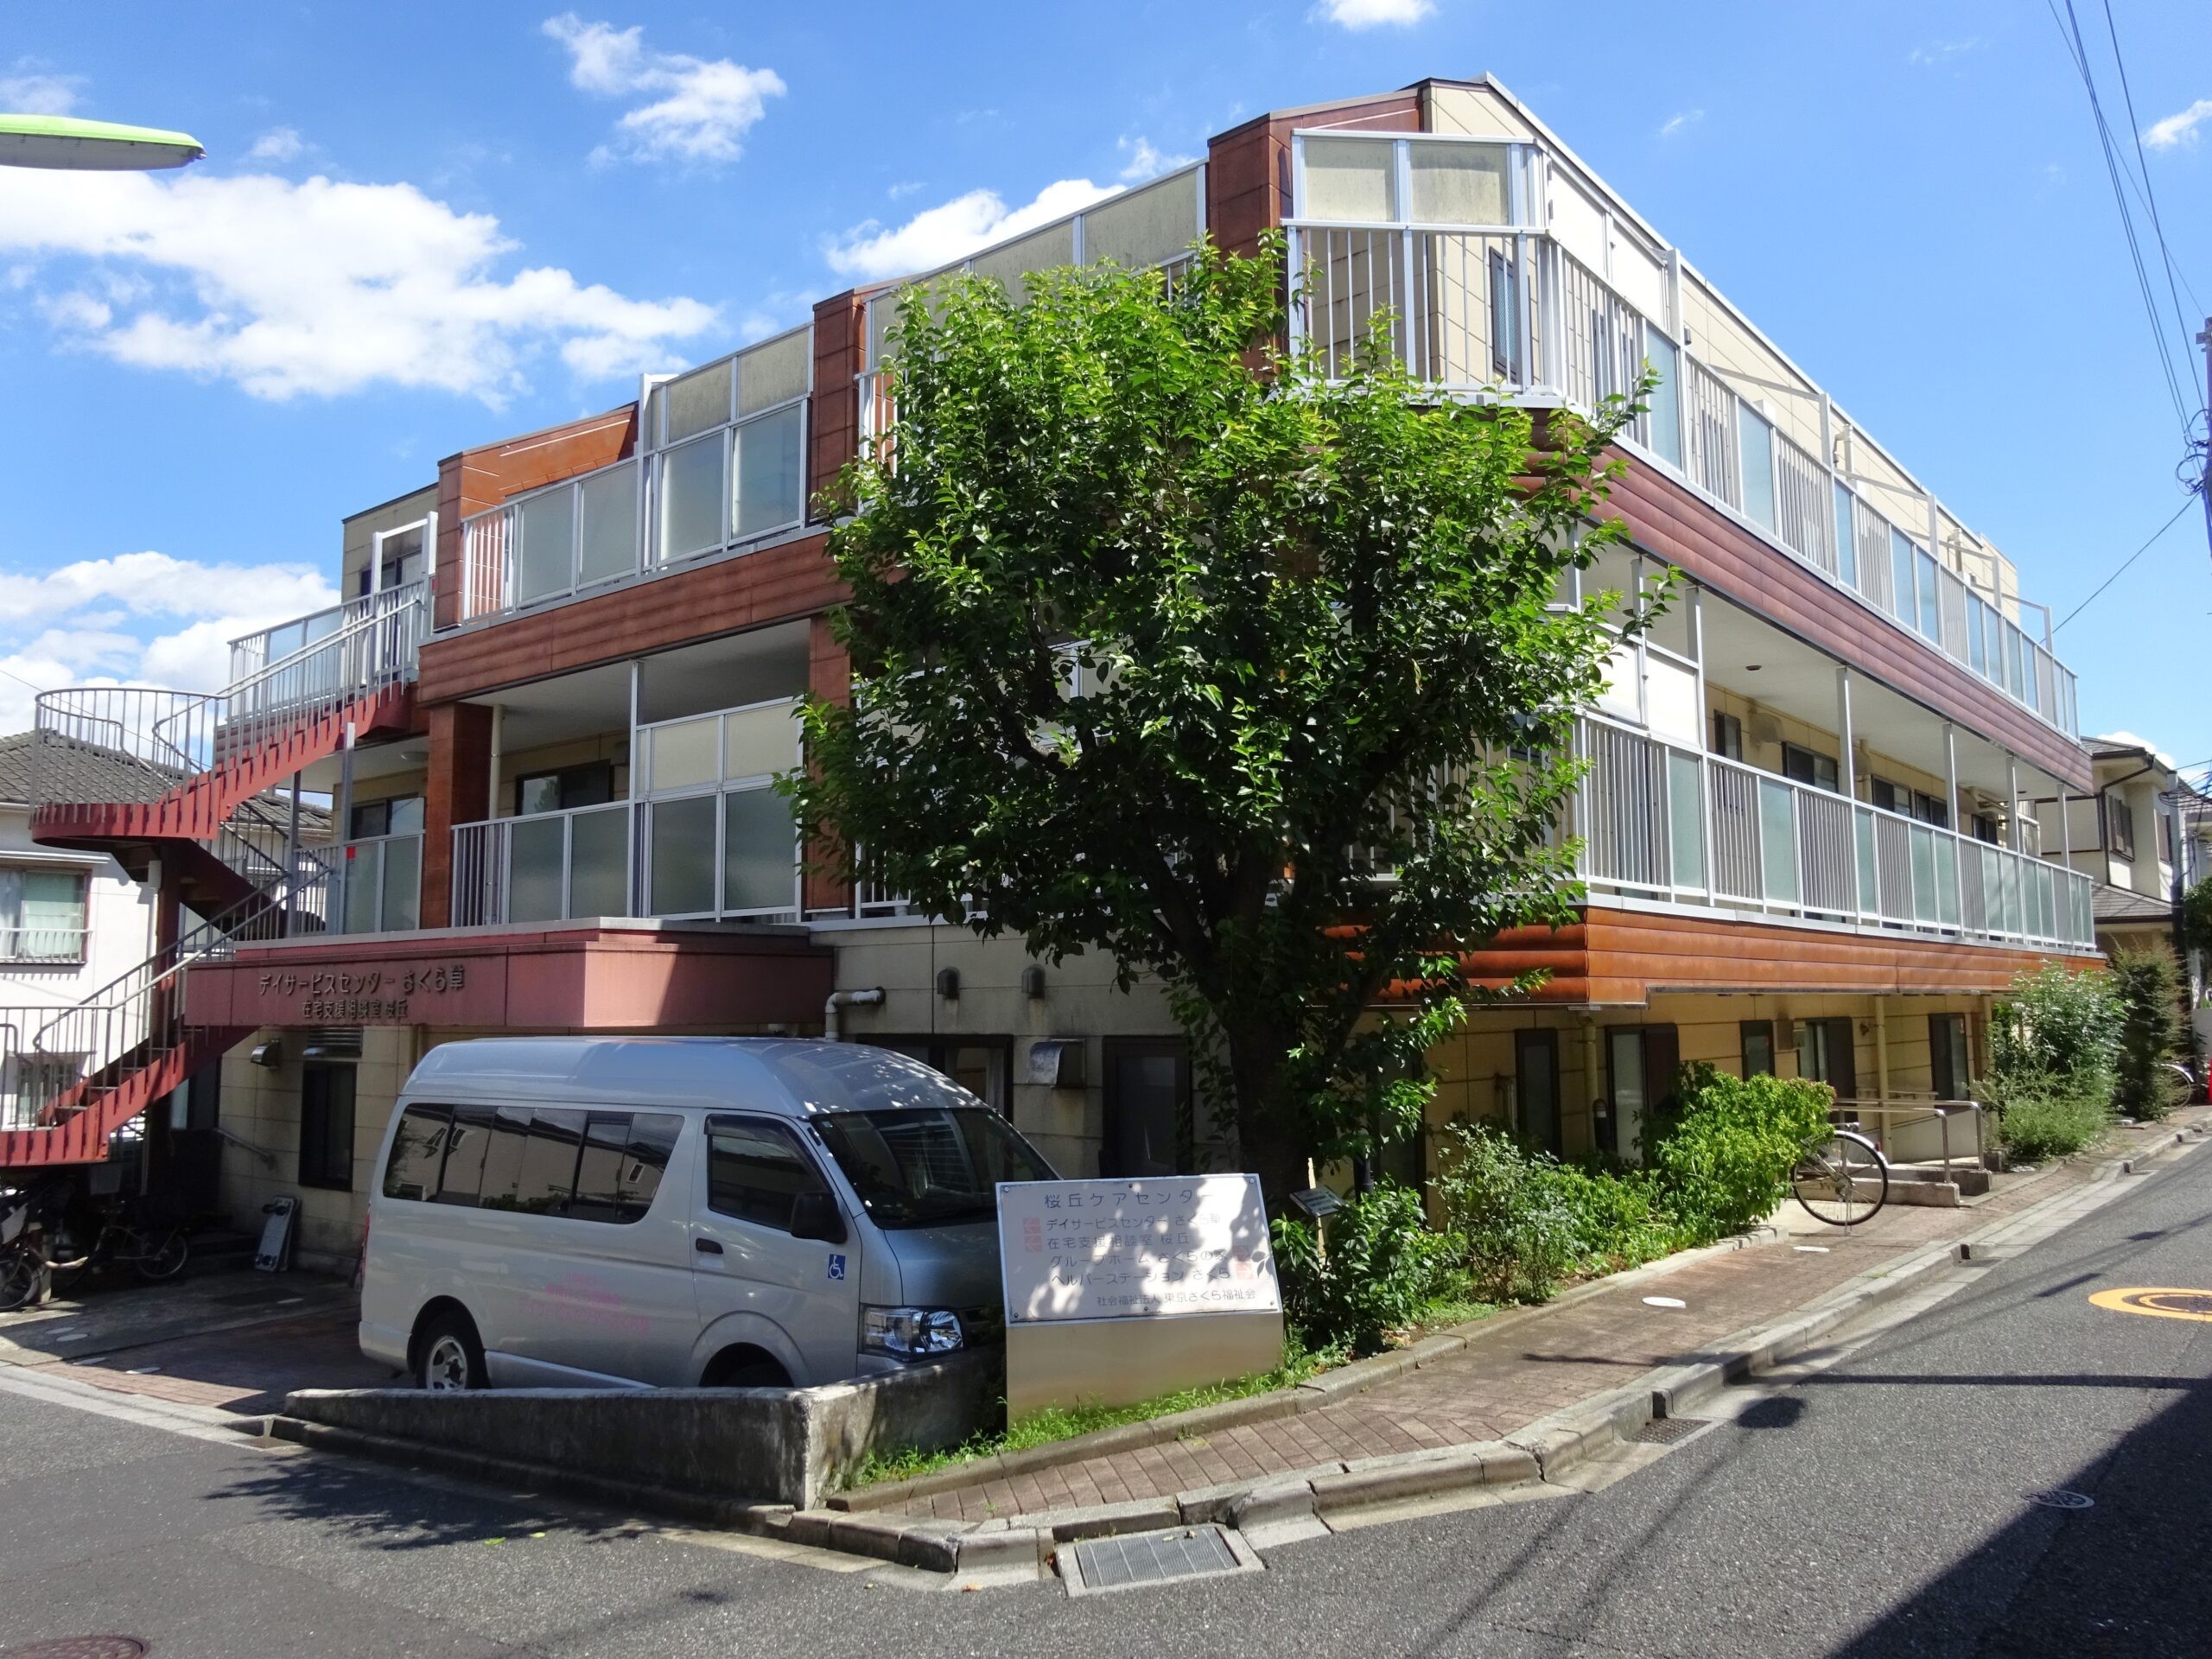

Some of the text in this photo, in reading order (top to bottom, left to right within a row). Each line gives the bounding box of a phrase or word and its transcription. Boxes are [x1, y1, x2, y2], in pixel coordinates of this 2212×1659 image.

[402, 964, 466, 993] さくら草
[1044, 1189, 1214, 1209] 桜丘ケアセンター
[1046, 1214, 1168, 1231] デイサービスセンター
[1047, 1232, 1190, 1249] 在宅支援相談室 桜丘
[1192, 1268, 1230, 1281] さくら
[1096, 1288, 1256, 1306] 社会福祉法人 東京さくら福祉会
